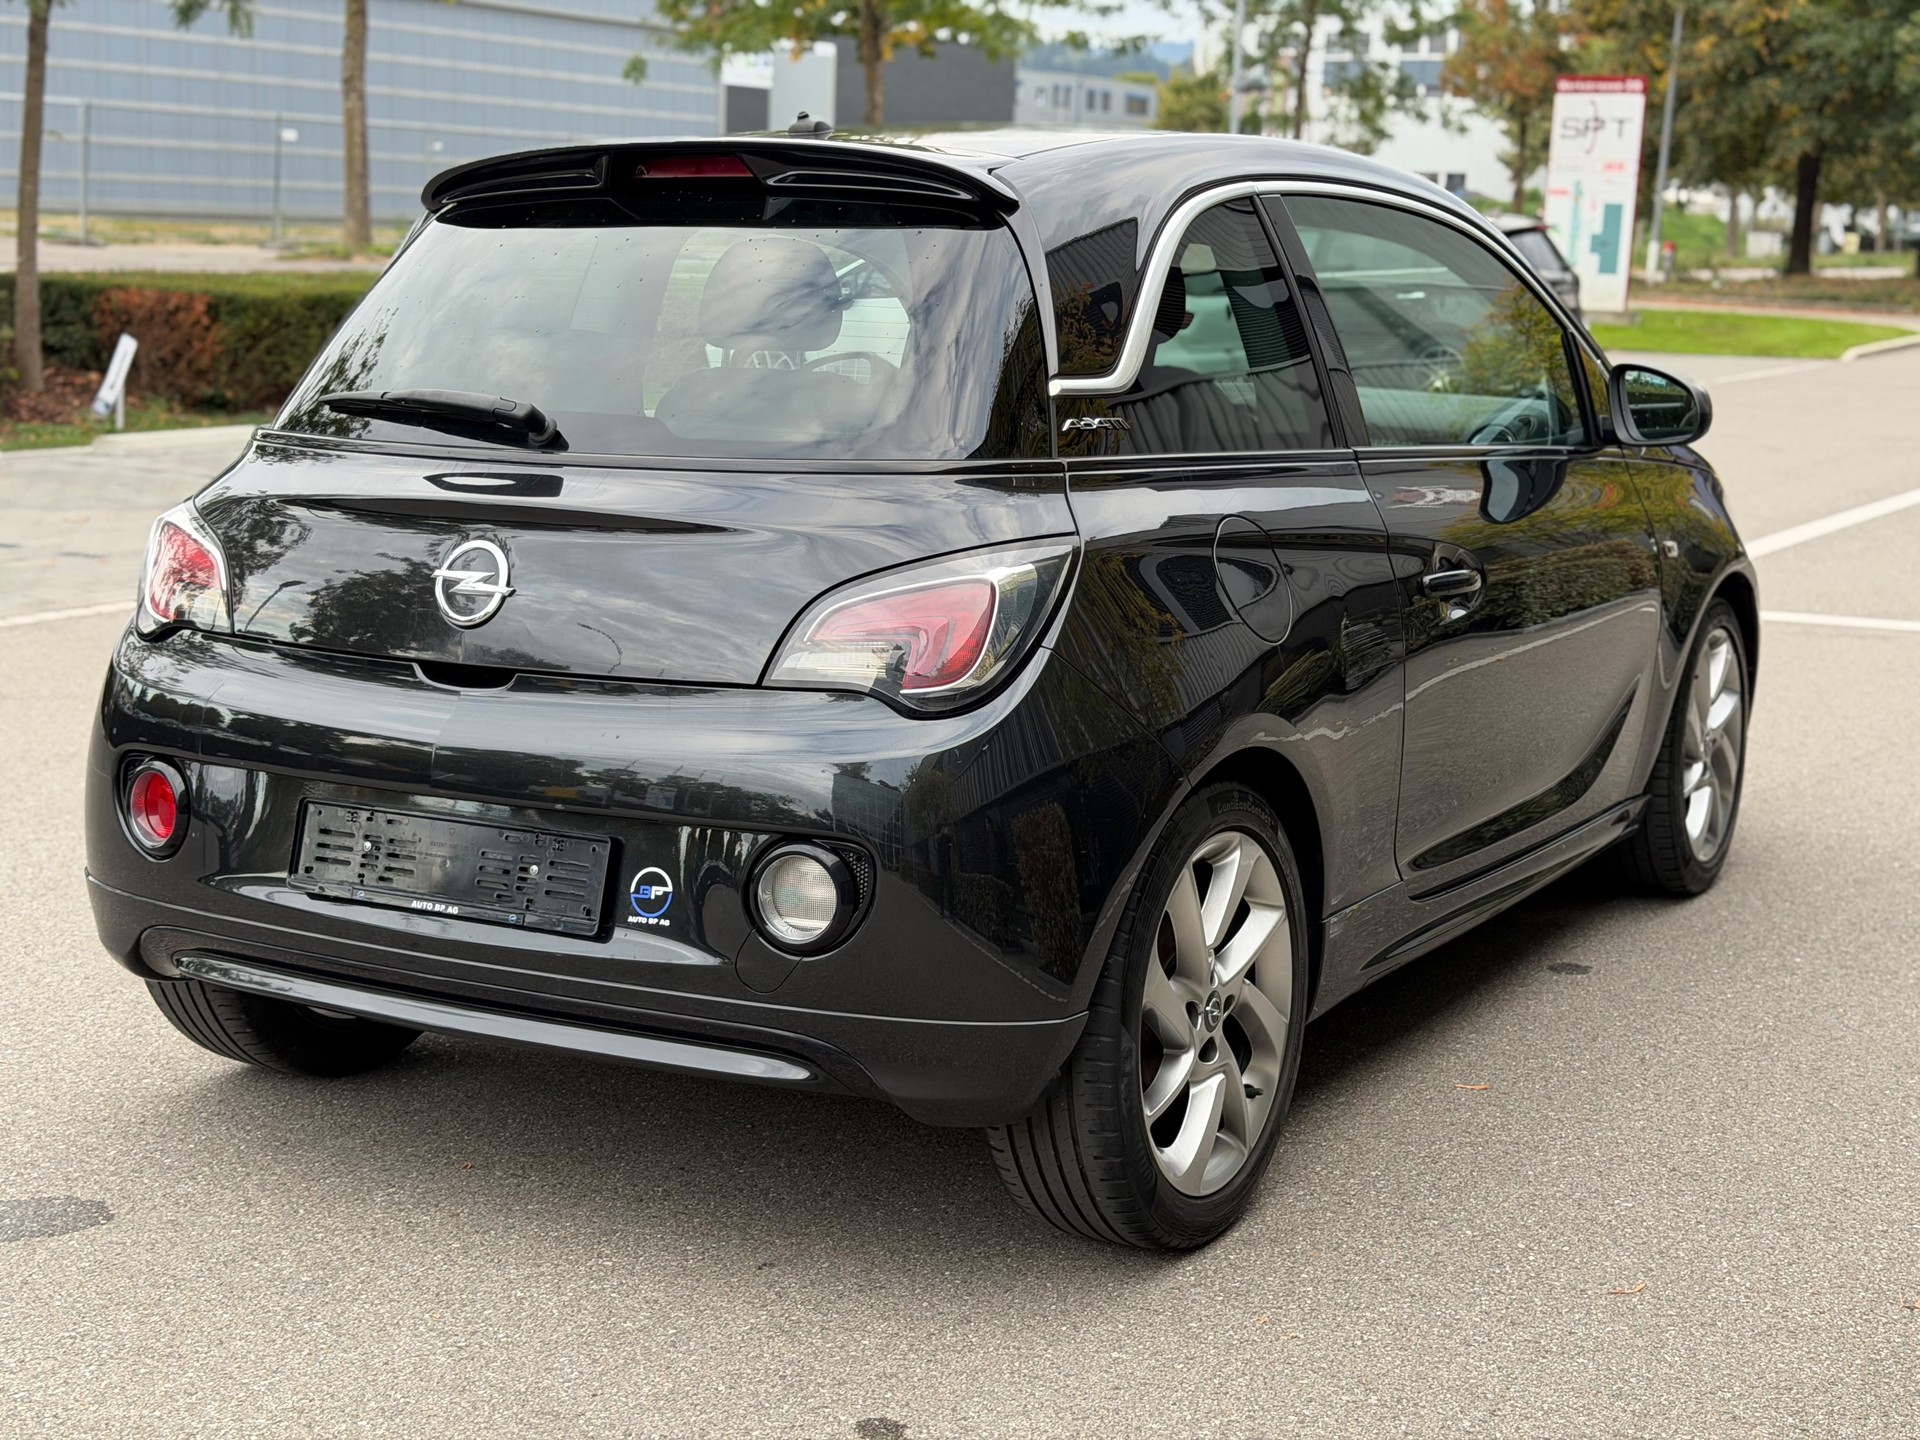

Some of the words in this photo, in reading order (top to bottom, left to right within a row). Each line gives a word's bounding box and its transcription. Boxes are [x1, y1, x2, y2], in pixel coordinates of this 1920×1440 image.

[411, 900, 433, 910] AUTO
[434, 903, 446, 912] BP
[447, 905, 459, 914] AG
